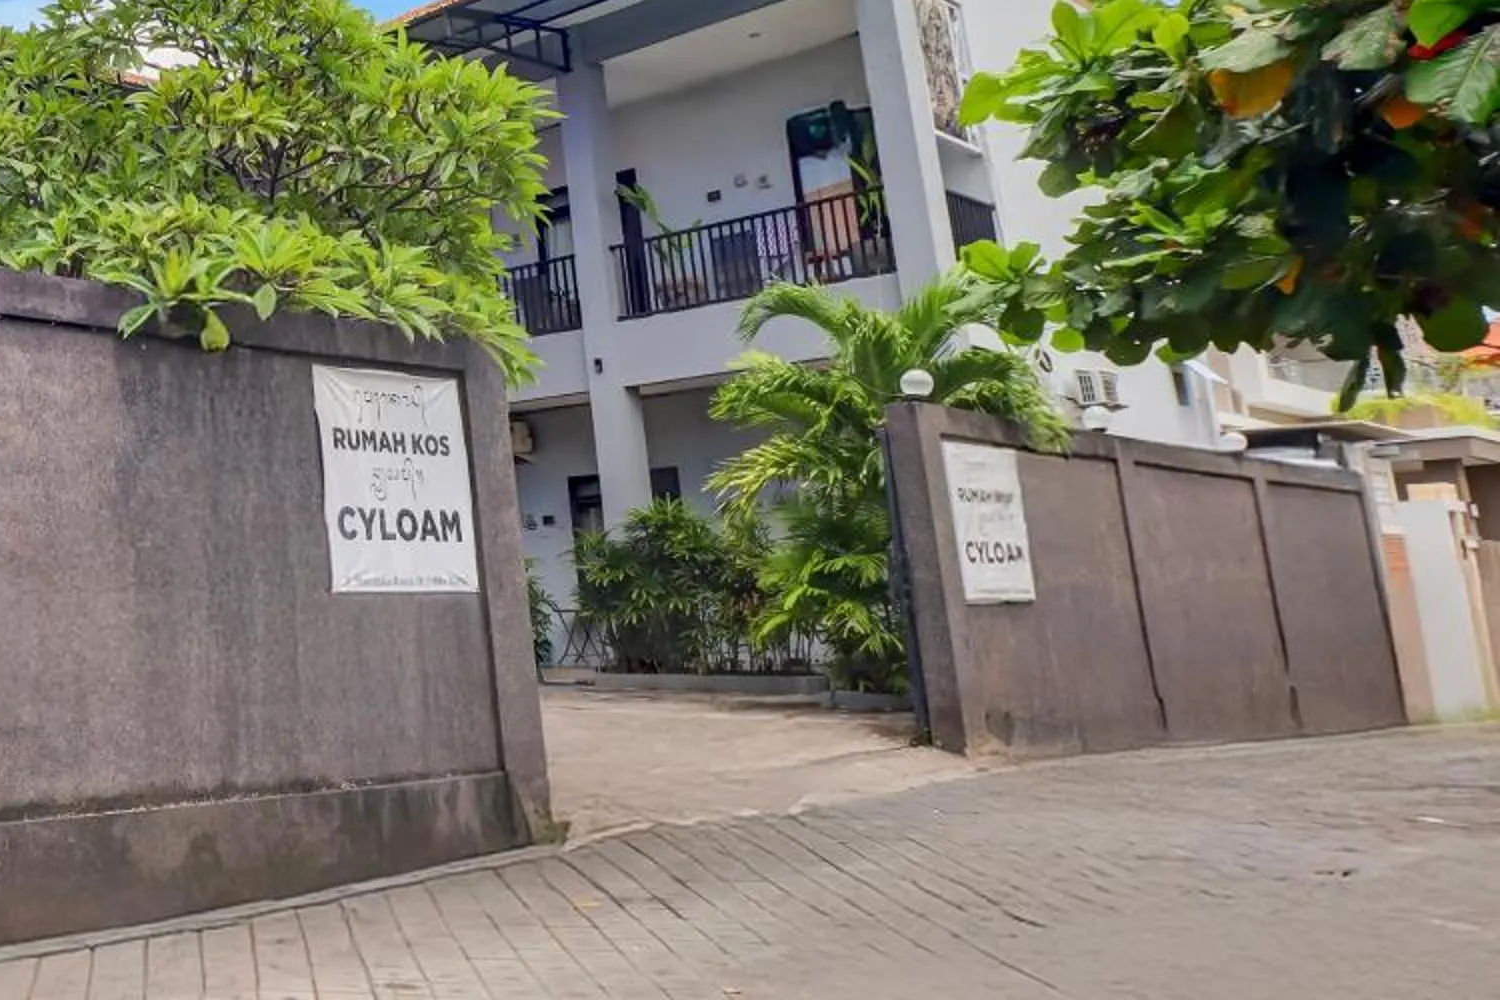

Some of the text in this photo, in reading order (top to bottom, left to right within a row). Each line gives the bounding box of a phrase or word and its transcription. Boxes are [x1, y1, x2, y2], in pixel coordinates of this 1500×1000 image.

[332, 427, 451, 457] RUMAH KOS
[337, 505, 463, 542] CYLOAM
